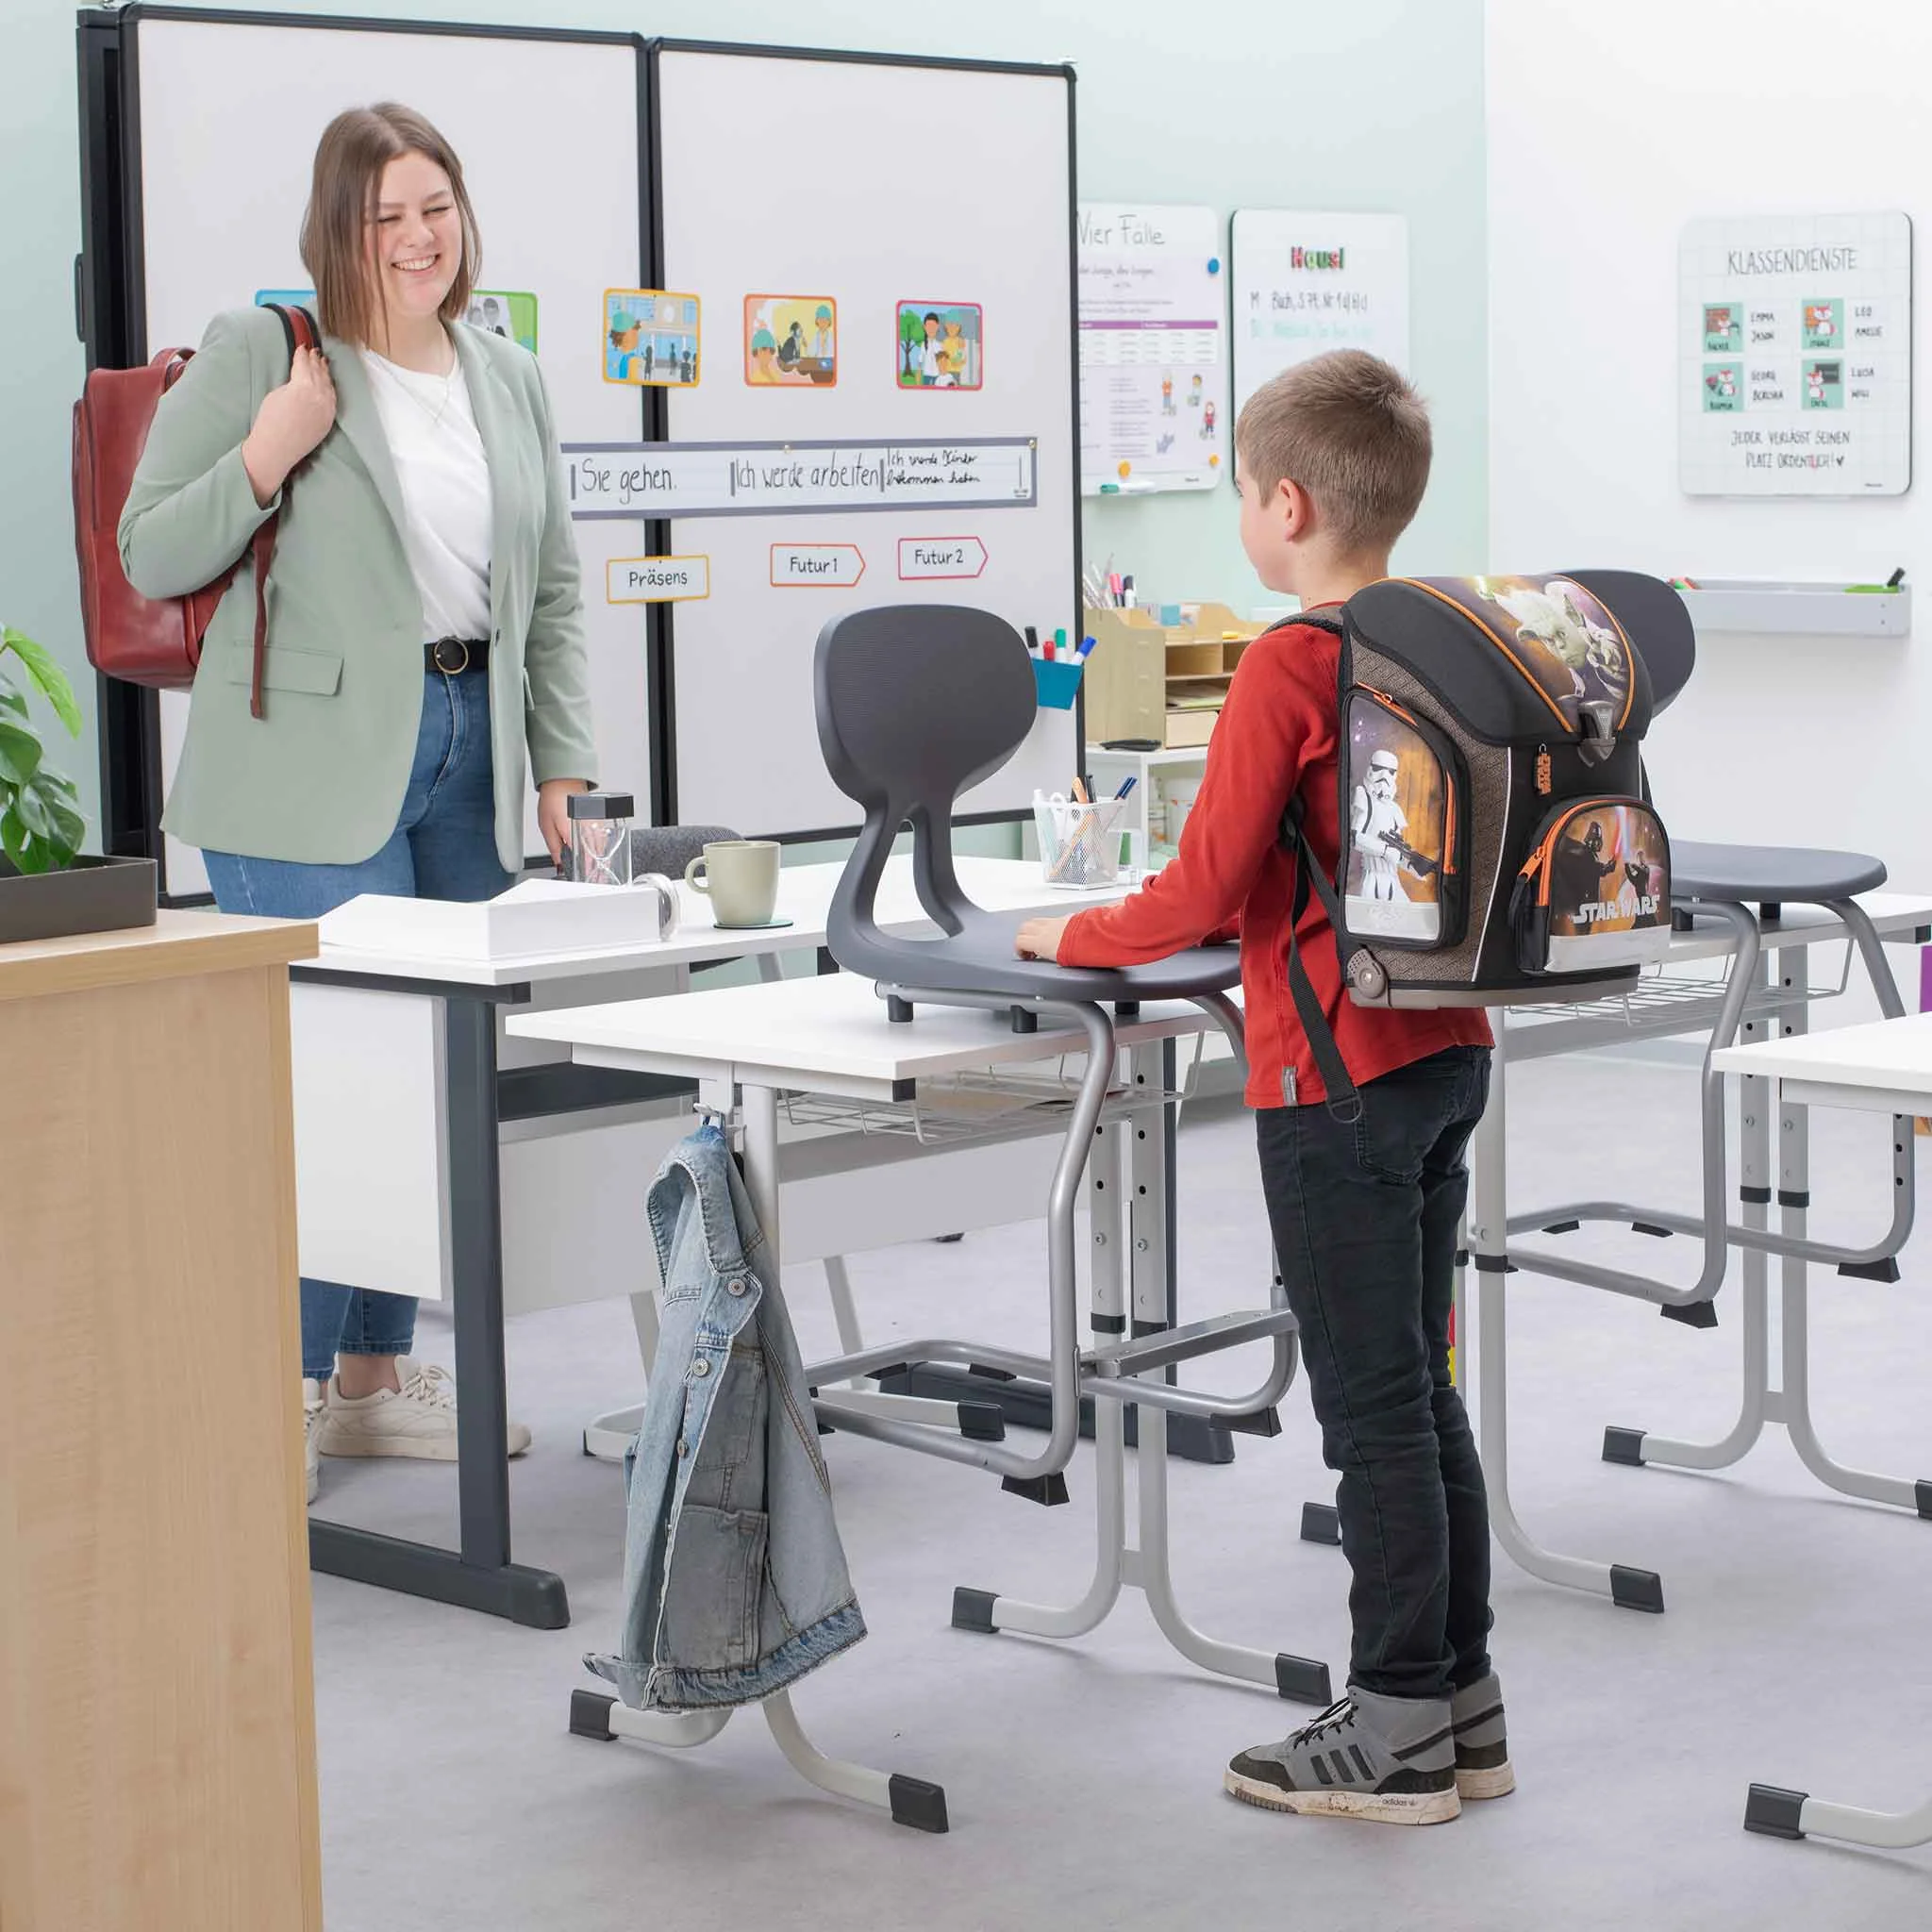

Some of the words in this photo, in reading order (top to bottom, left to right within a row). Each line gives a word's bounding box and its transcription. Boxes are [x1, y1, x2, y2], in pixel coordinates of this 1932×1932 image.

[1077, 209, 1112, 245] Vier
[1728, 247, 1859, 276] KLASSENDIENSTE
[887, 446, 904, 466] Ich
[582, 458, 611, 491] Sie
[619, 462, 677, 505] gehen.
[736, 458, 756, 489] Ich
[762, 461, 802, 489] werde
[810, 450, 879, 488] arbeiten
[948, 471, 980, 484] haben
[790, 557, 830, 574] Futur
[832, 558, 838, 573] 1
[914, 549, 954, 565] Futur
[956, 549, 964, 564] 2
[628, 569, 688, 587] Präsens
[1573, 901, 1618, 924] STAR
[1619, 895, 1660, 918] WARS
